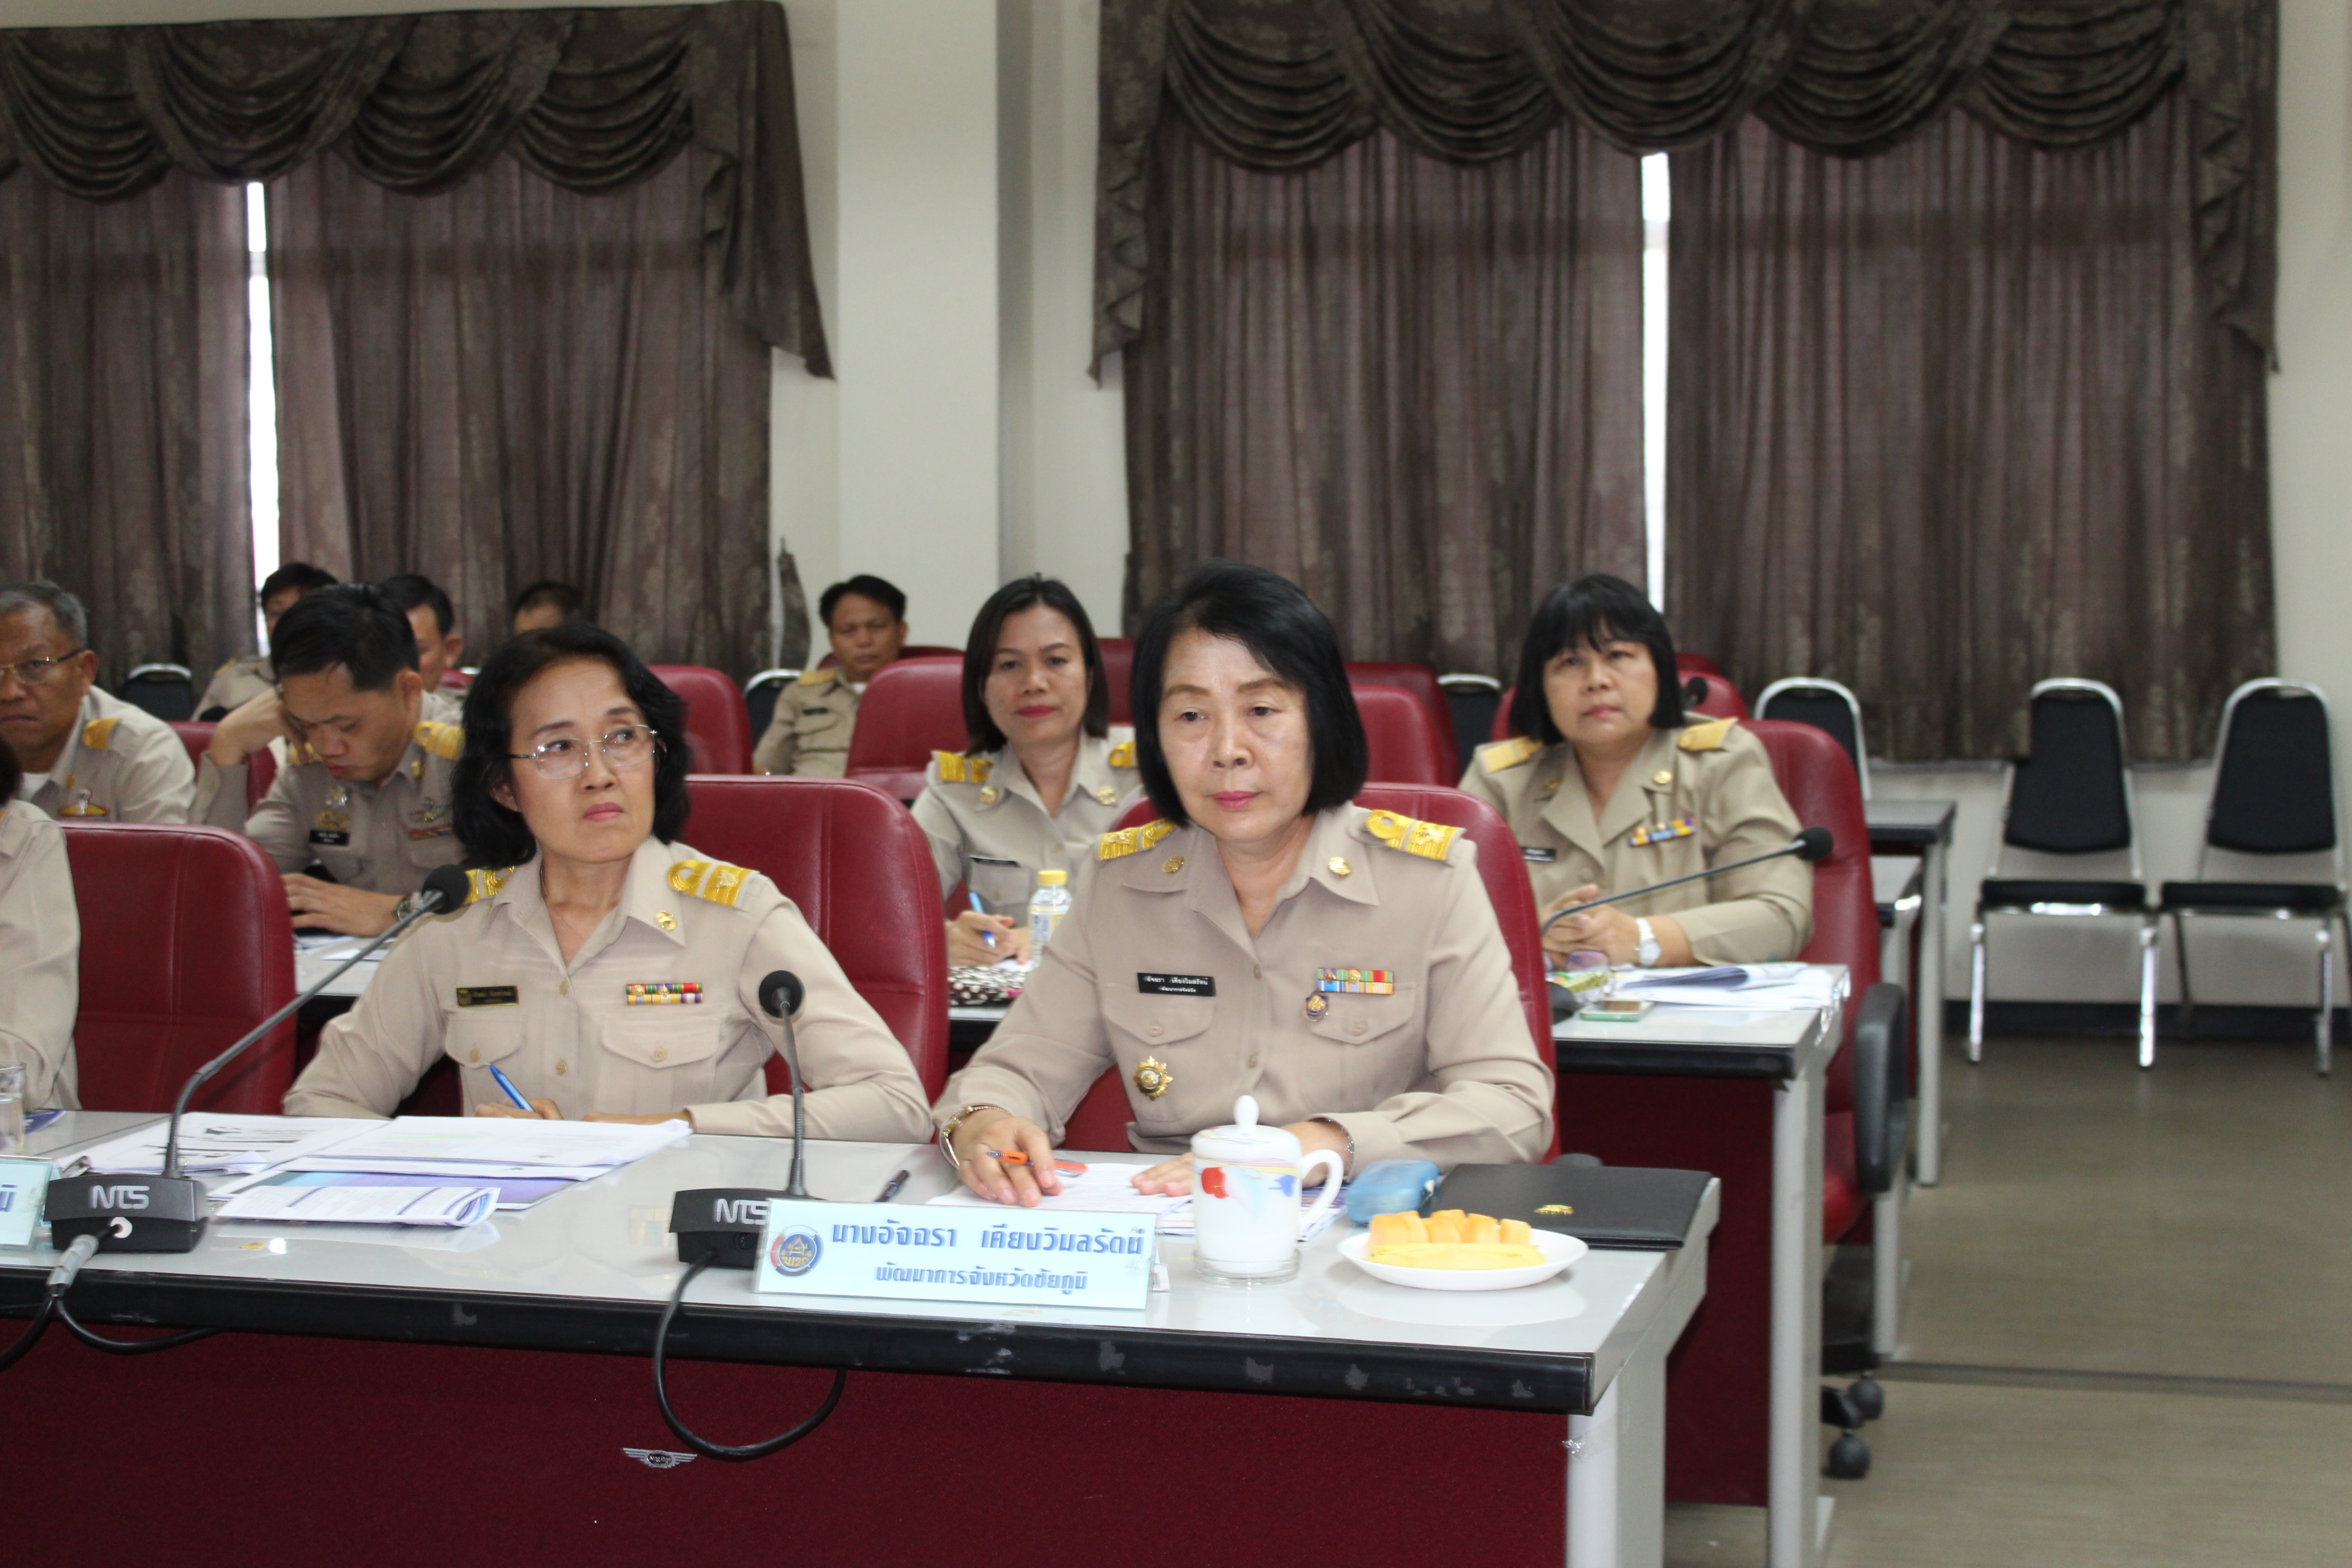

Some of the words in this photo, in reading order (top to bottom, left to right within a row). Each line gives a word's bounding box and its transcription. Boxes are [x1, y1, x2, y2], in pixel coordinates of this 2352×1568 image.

[91, 1185, 150, 1210] NTS
[832, 1219, 957, 1247] นางอัจฉรา
[981, 1224, 1144, 1254] เคียงวิมลรัตน์
[876, 1262, 1087, 1294] พัฒนาการจังหวัดชัยภูมิ
